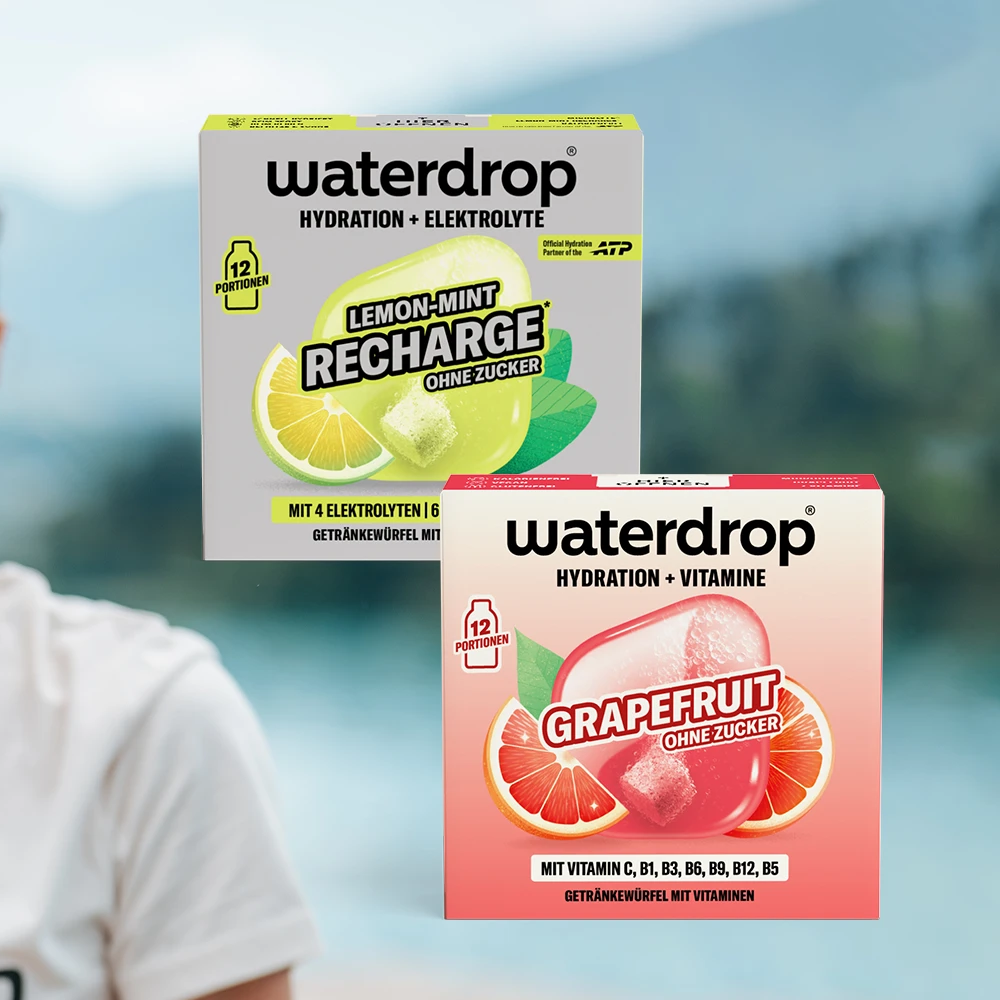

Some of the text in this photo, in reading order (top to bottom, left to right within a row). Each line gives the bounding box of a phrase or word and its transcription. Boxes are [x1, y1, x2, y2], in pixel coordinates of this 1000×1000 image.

[299, 210, 404, 228] HYDRATION
[424, 210, 545, 228] ELEKTROLYTE
[543, 240, 592, 249] Official Hydration
[590, 241, 633, 256] ATP
[230, 260, 251, 278] 12
[215, 275, 269, 294] PORTIONEN
[349, 284, 497, 330] LEMON-MINT
[426, 357, 540, 391] OHNE ZUCKER
[288, 503, 313, 518] MIT
[315, 503, 324, 518] 4
[326, 503, 421, 518] ELEKTROLYTEN
[431, 503, 440, 518] 6
[312, 526, 441, 541] GETRÄNKEWÜRFEL MIT
[556, 569, 660, 587] HYDRATION
[680, 569, 766, 587] VITAMINE
[470, 618, 491, 637] 12
[455, 633, 509, 653] PORTIONEN
[546, 675, 777, 744] GRAPEFRUIT
[664, 717, 778, 749] OHNE ZUCKER
[541, 861, 779, 879] MIT VITAMIN C, B1, B3, B6, B9, B12, B5
[565, 887, 755, 902] GETRÄNKEWÜRFEL MIT VITAMINEN
